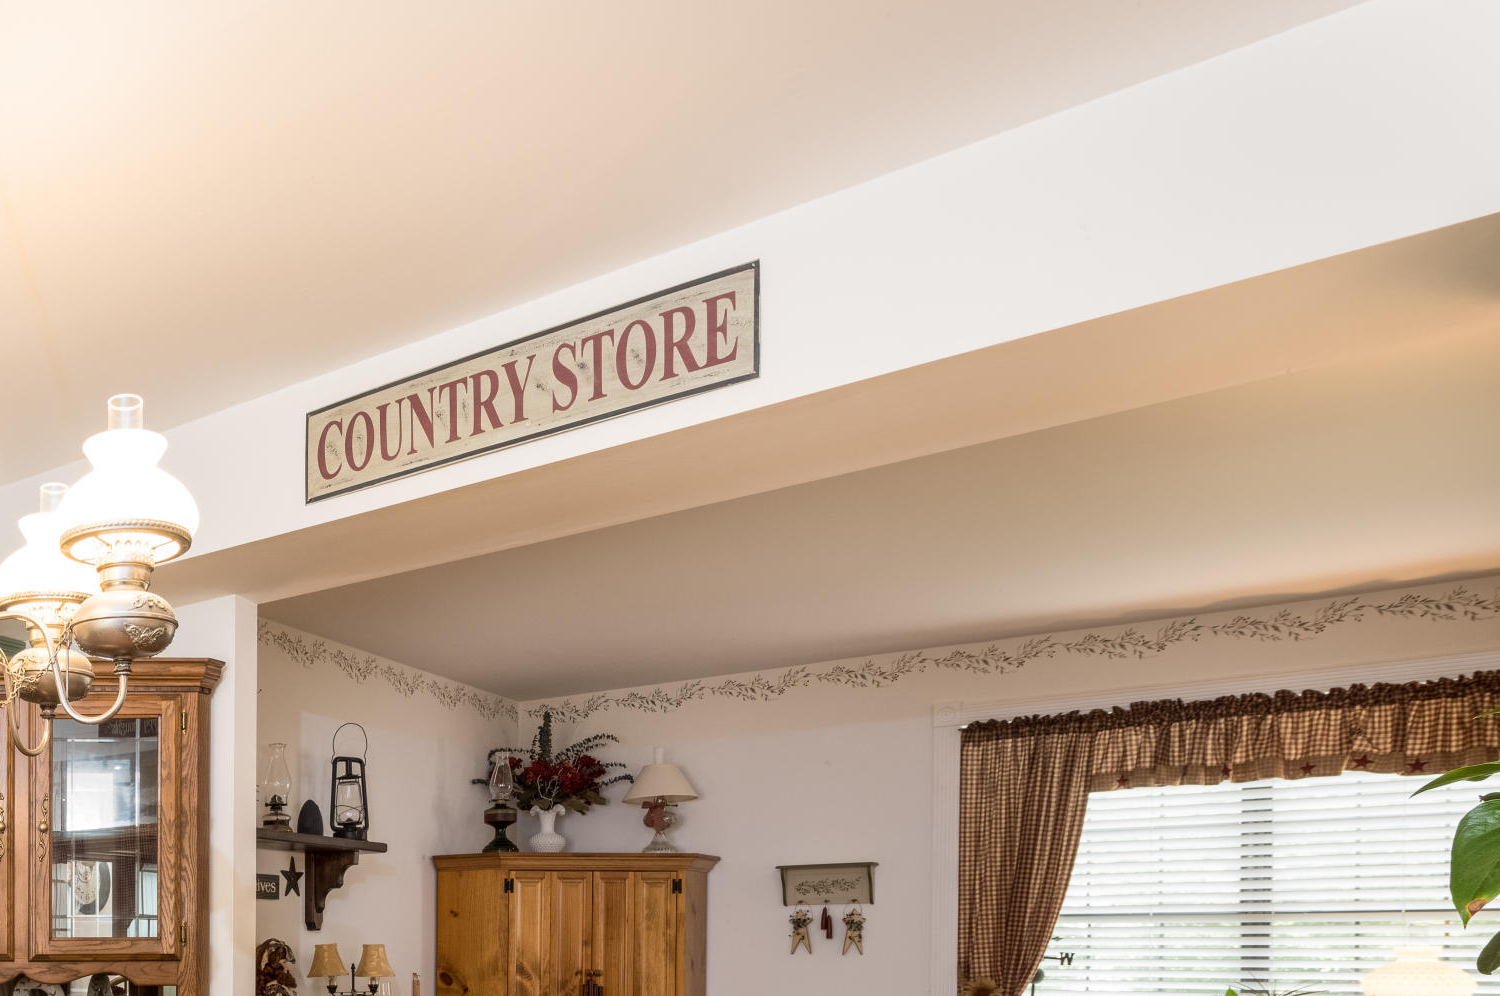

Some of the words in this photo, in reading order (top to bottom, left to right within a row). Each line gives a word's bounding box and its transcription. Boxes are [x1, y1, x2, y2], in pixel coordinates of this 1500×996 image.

[316, 354, 537, 481] COUNTRY
[551, 290, 739, 413] STORE
[257, 878, 277, 893] ives
